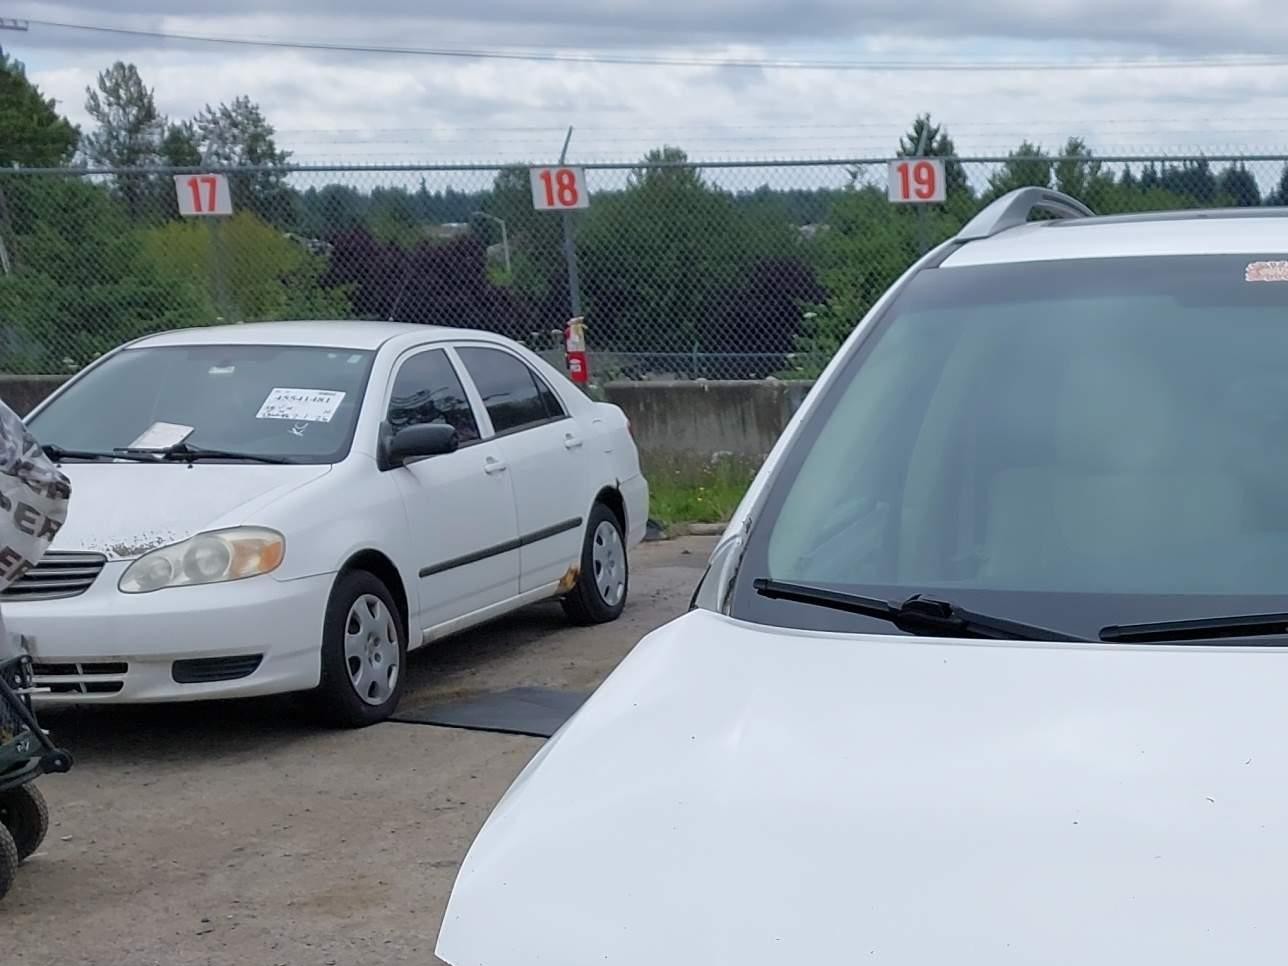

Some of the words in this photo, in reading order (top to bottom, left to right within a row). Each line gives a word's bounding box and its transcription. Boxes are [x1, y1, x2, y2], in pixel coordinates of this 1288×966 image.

[187, 177, 218, 212] 17
[540, 169, 579, 207] 18
[897, 161, 937, 200] 19
